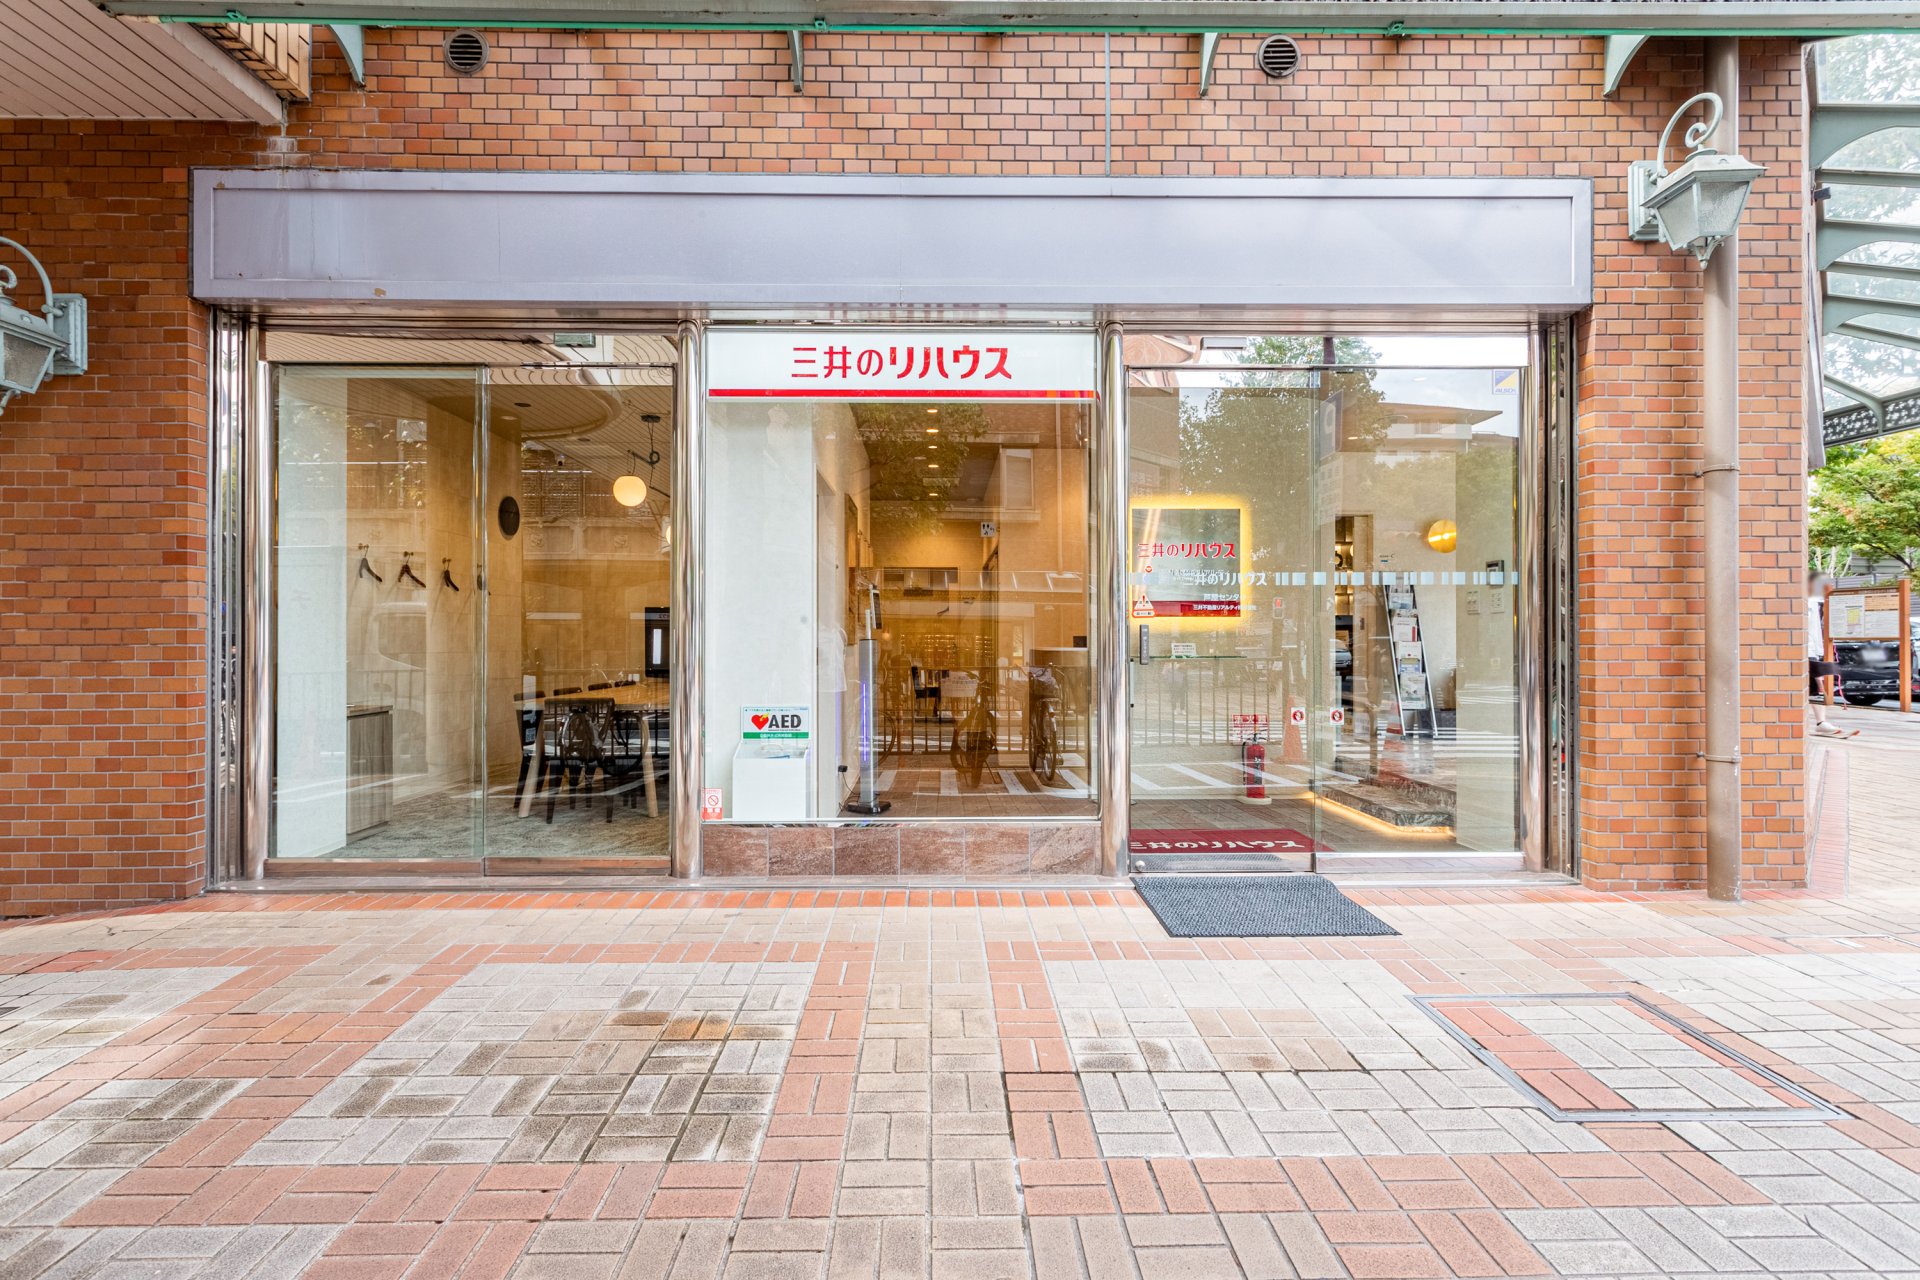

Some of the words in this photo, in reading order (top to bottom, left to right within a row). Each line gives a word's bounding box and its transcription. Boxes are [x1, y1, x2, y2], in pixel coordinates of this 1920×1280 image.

[791, 345, 1012, 380] 三井のリハウス
[1138, 542, 1236, 559] 三井のリハウス
[1183, 572, 1268, 586] 三井のリハウス
[768, 714, 802, 729] AED
